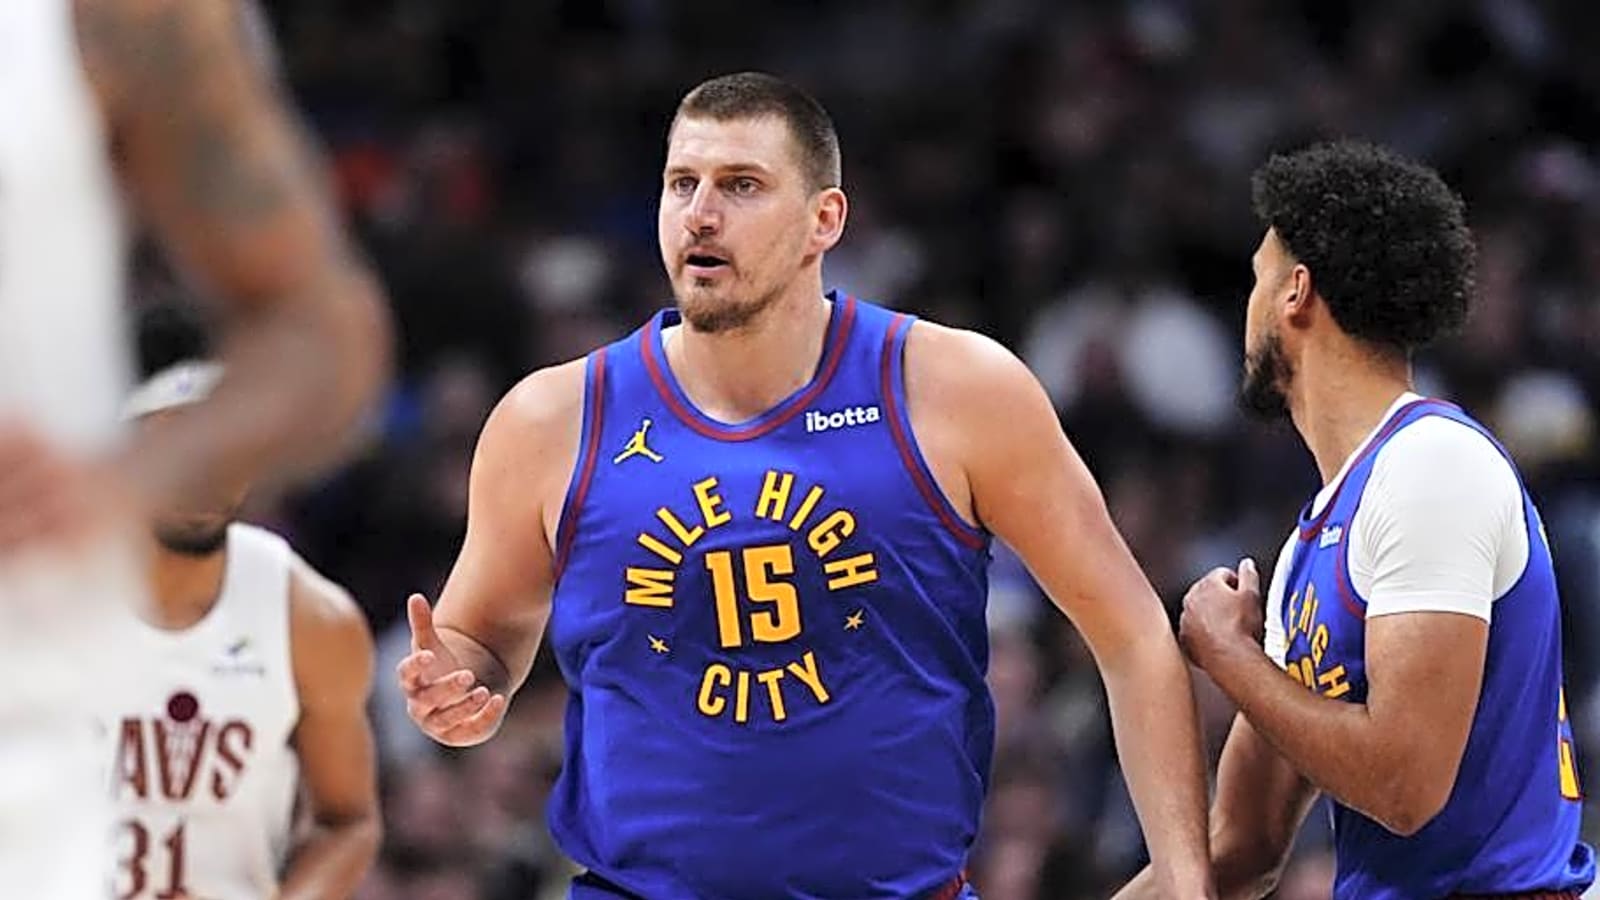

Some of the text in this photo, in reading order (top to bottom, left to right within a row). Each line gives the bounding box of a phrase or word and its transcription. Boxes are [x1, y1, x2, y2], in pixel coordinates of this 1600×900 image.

[806, 406, 880, 432] ibotta
[625, 470, 878, 607] MILE HIGH
[705, 544, 801, 647] 15
[697, 651, 830, 722] CITY
[112, 717, 253, 801] AVS
[114, 817, 188, 900] 31
